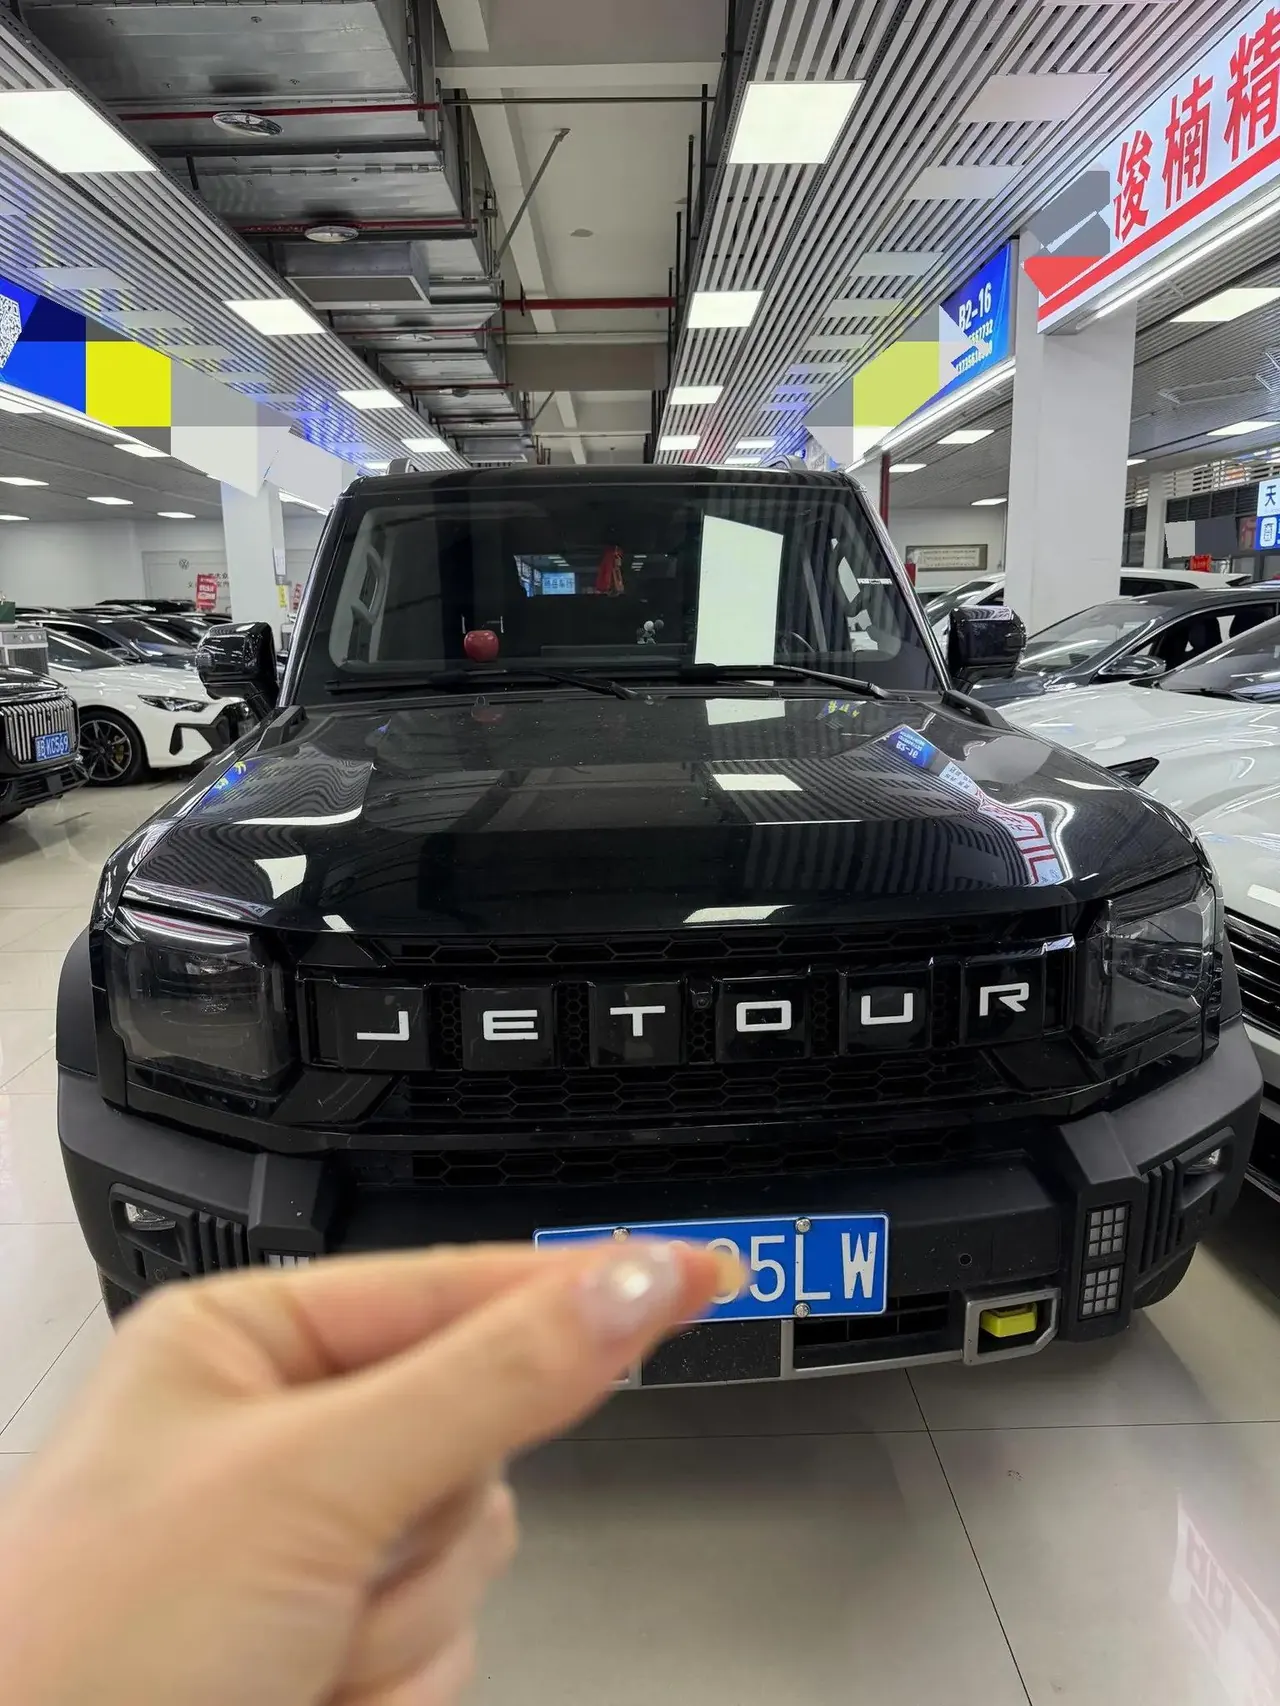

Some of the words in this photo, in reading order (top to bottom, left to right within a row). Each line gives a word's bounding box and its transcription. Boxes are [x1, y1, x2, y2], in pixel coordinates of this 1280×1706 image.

[1113, 7, 1280, 243] 俊楠精
[959, 282, 992, 332] B2-16
[1264, 484, 1277, 507] 天
[356, 981, 1030, 1042] JETOUR
